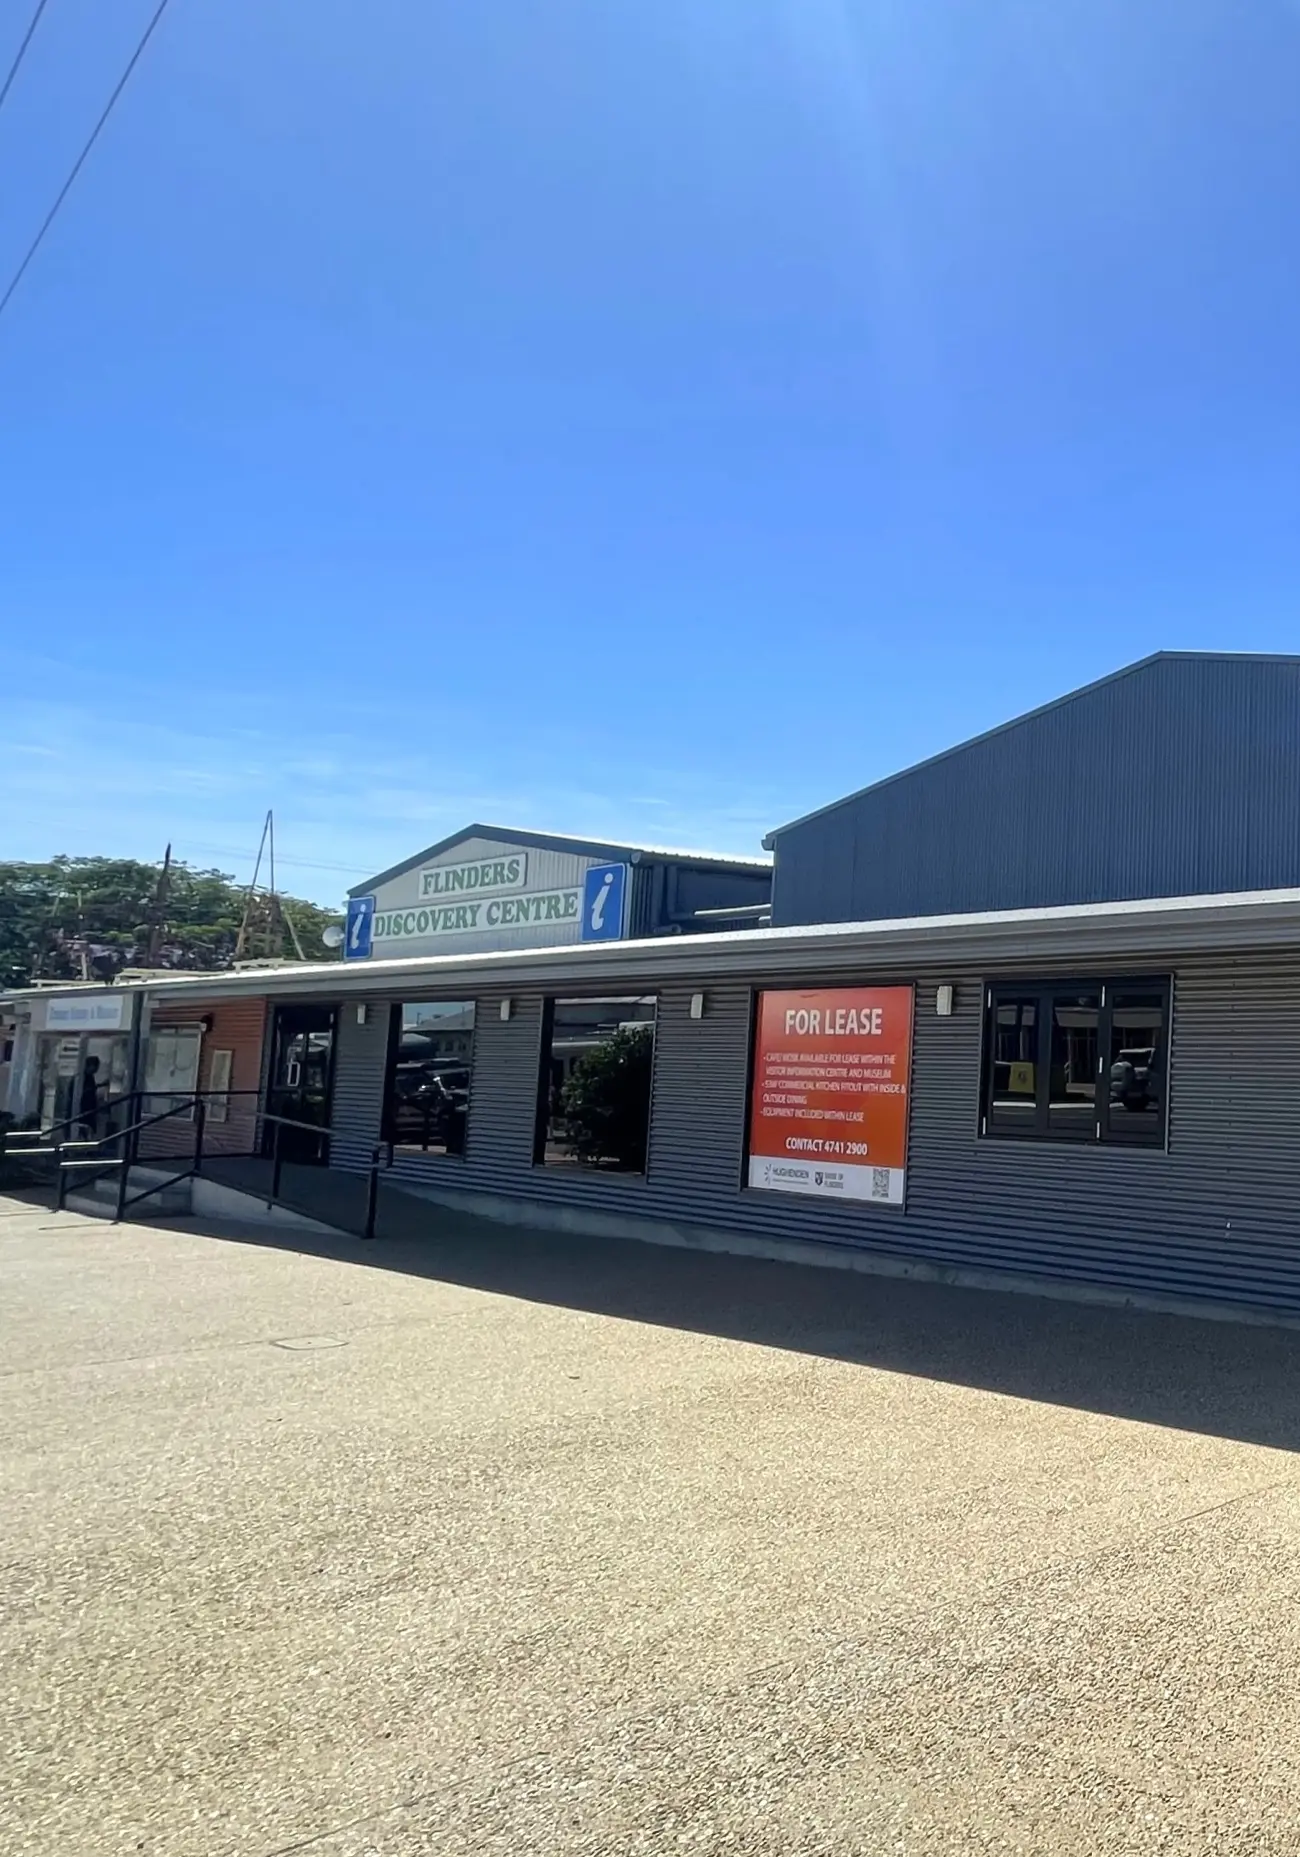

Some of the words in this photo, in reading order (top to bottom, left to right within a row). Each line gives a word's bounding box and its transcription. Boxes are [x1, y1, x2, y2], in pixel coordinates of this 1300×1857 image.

[422, 858, 521, 895] FLINDERS
[374, 904, 482, 937] DISCOVERY
[487, 892, 579, 926] CENTRE
[785, 1009, 821, 1035] FOR
[825, 1008, 883, 1035] LEASE
[842, 1054, 860, 1064] LEASE
[884, 1054, 896, 1064] THE
[849, 1068, 863, 1078] AND
[864, 1069, 891, 1079] MUSEUM
[879, 1083, 900, 1093] INSIDE
[845, 1112, 864, 1122] LEASE
[786, 1137, 823, 1153] CONTACT
[824, 1140, 844, 1154] 4741
[846, 1142, 868, 1156] 2900
